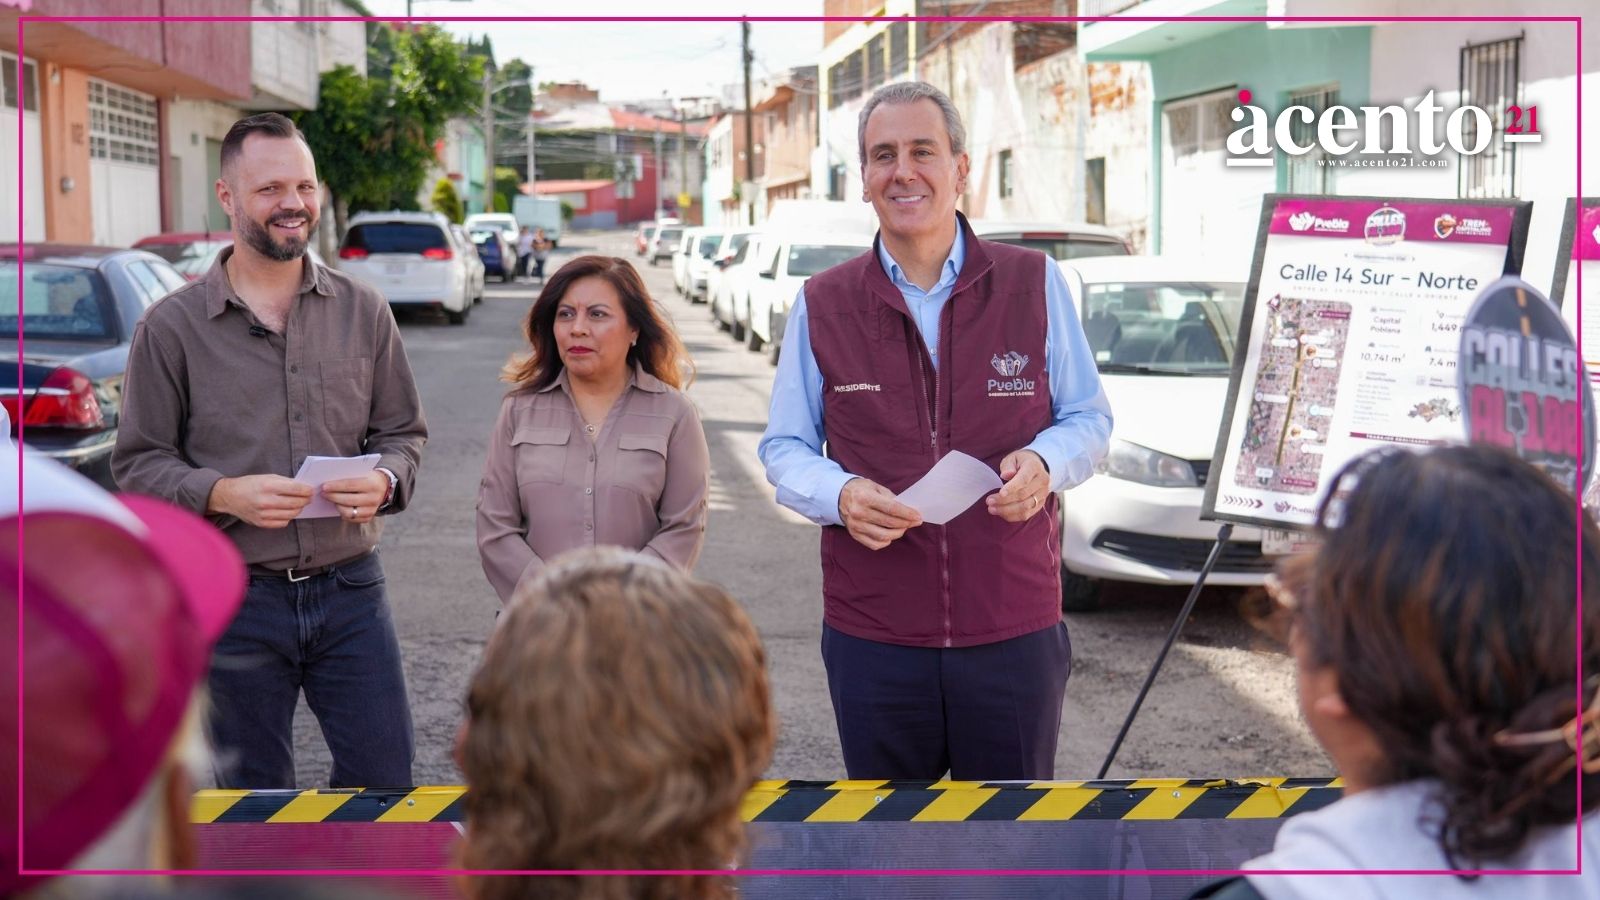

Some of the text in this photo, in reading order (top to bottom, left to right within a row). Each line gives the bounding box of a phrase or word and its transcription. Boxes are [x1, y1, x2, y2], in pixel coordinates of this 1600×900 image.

[1280, 264, 1328, 282] Calle
[1335, 267, 1353, 283] 14
[1360, 268, 1394, 286] Sur
[1417, 271, 1478, 291] Norte
[1370, 326, 1401, 334] Poblana
[1373, 317, 1401, 325] Capital
[1463, 328, 1584, 400] CALLES
[987, 377, 1035, 392] Puebla
[1471, 384, 1515, 449] AL
[1521, 390, 1585, 459] 100
